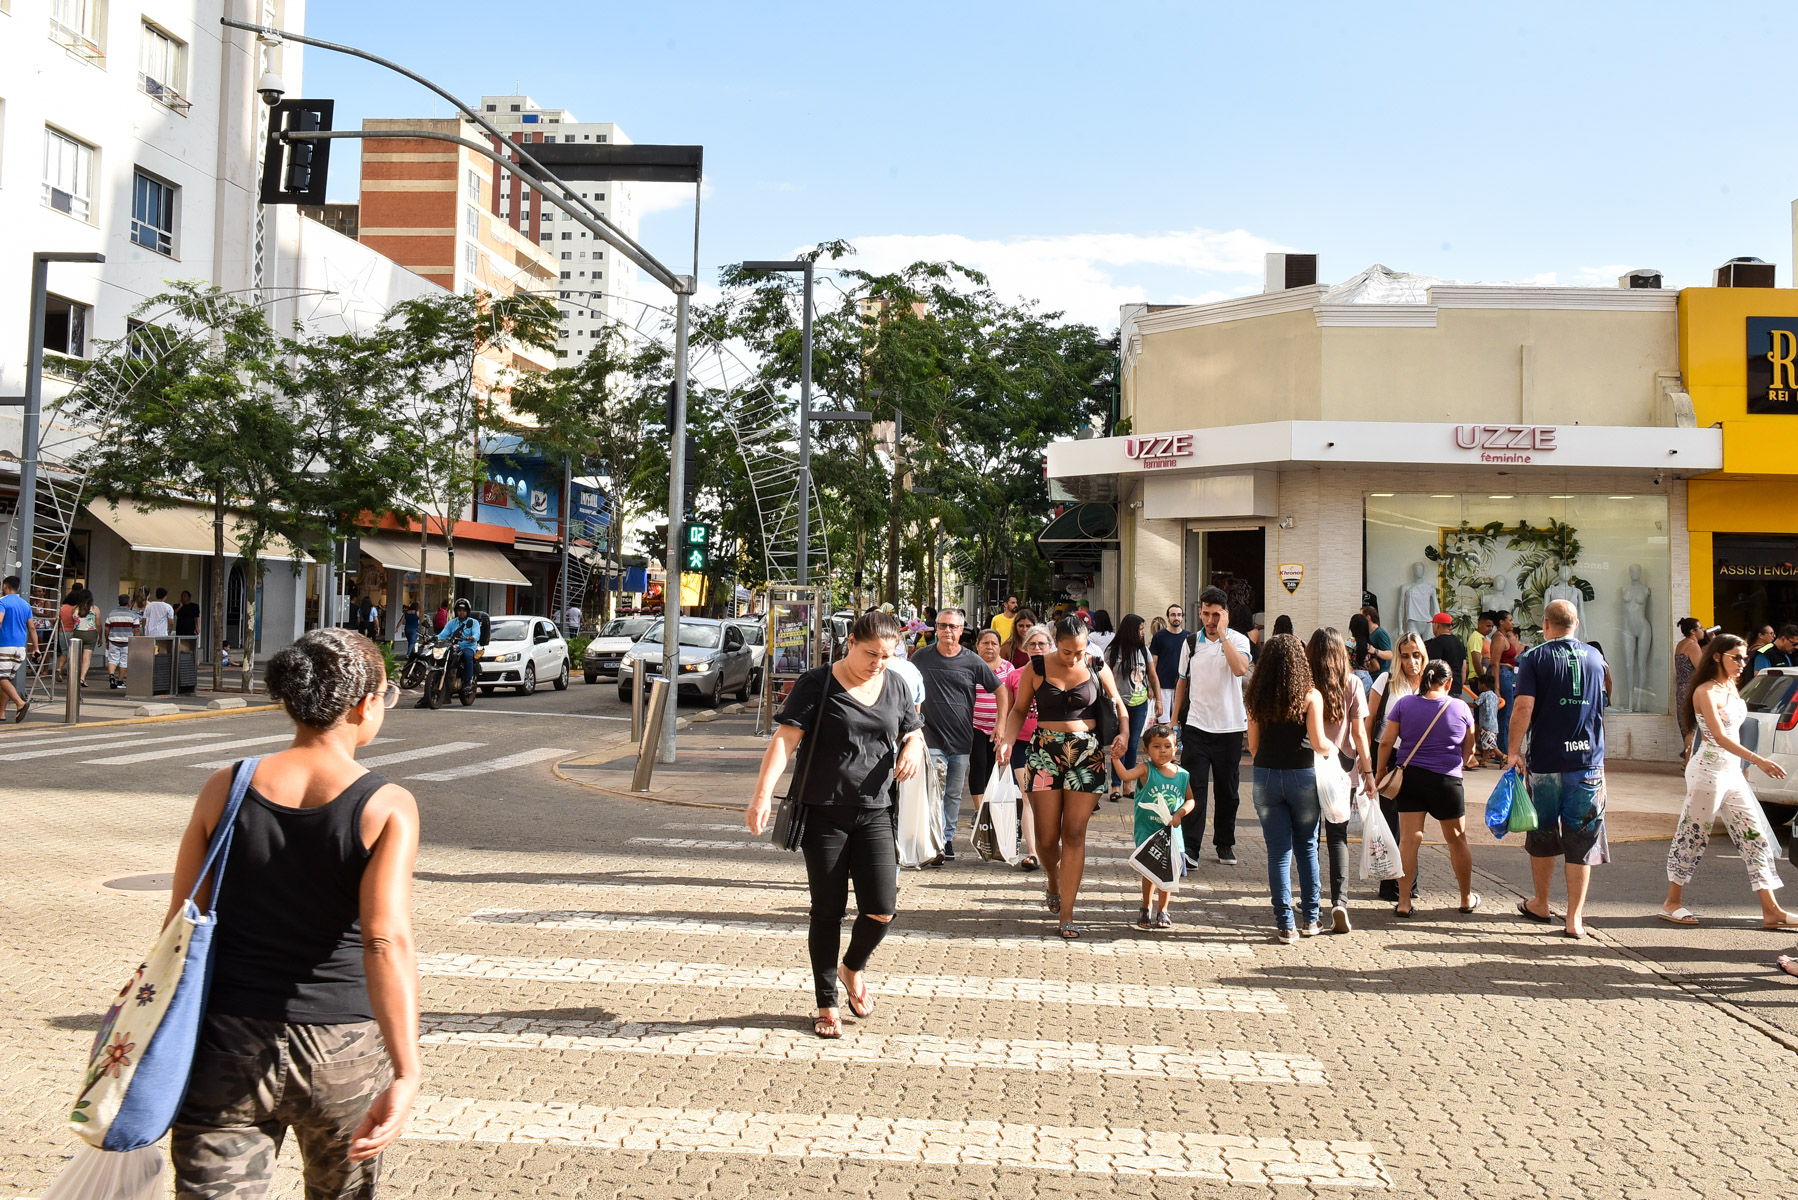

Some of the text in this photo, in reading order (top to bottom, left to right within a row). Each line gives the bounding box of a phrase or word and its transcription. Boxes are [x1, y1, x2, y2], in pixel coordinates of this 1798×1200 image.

[1767, 329, 1798, 389] R
[1768, 390, 1788, 401] REI
[1455, 425, 1558, 450] UZZE
[1124, 434, 1193, 460] UZZE
[1143, 457, 1177, 469] feminine
[1480, 452, 1531, 463] feminine
[690, 526, 705, 542] 02
[1567, 659, 1581, 696] 1
[1564, 740, 1591, 752] TIGRE
